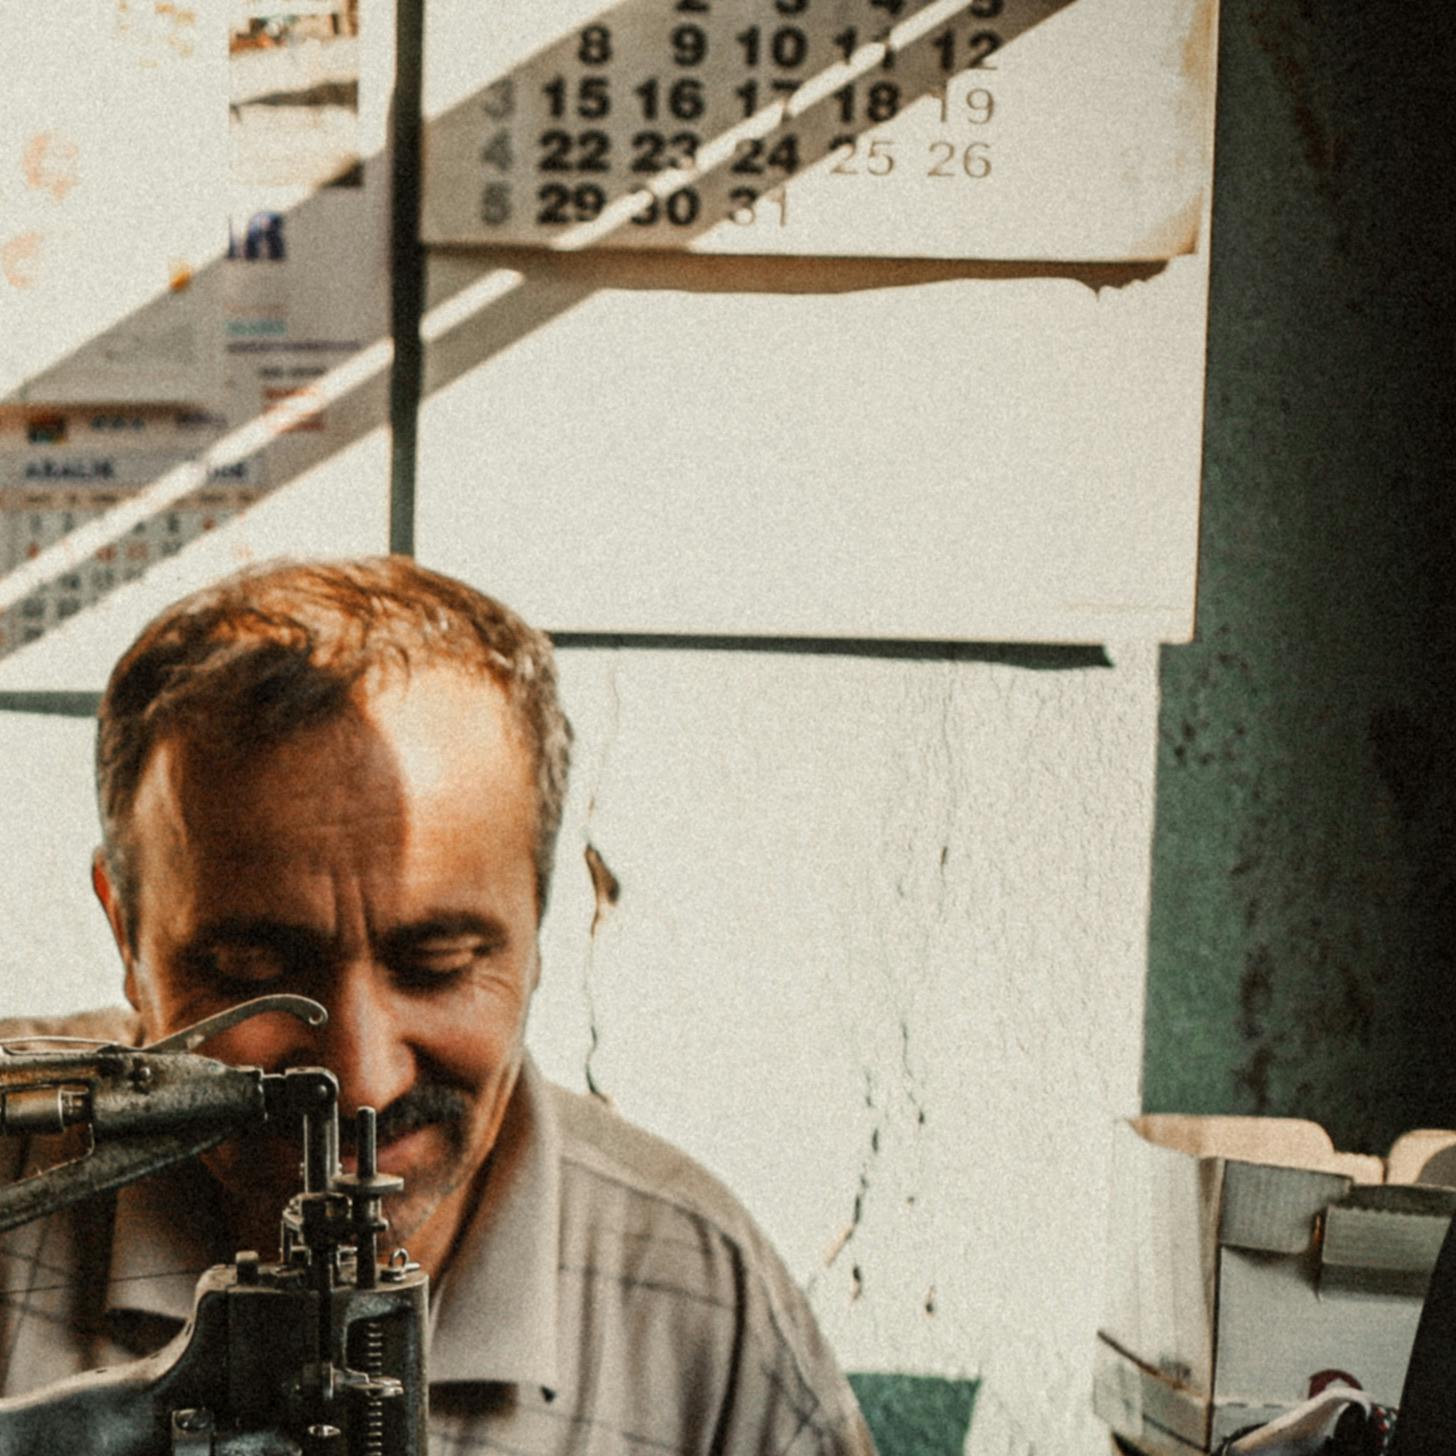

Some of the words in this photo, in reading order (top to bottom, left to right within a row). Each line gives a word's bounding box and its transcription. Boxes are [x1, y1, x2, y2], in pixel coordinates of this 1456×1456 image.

[579, 26, 613, 64] 8
[672, 27, 707, 66] 9
[736, 28, 807, 67] 10
[932, 31, 1001, 71] 12
[542, 79, 611, 120] 15
[636, 80, 705, 121] 16
[834, 83, 900, 123] 18
[932, 86, 996, 124] 19
[538, 131, 611, 173] 22
[631, 132, 703, 174] 23
[731, 135, 800, 177] 24
[828, 138, 895, 178] 25
[926, 140, 994, 179] 26
[536, 183, 606, 226] 29
[728, 186, 790, 229] 31
